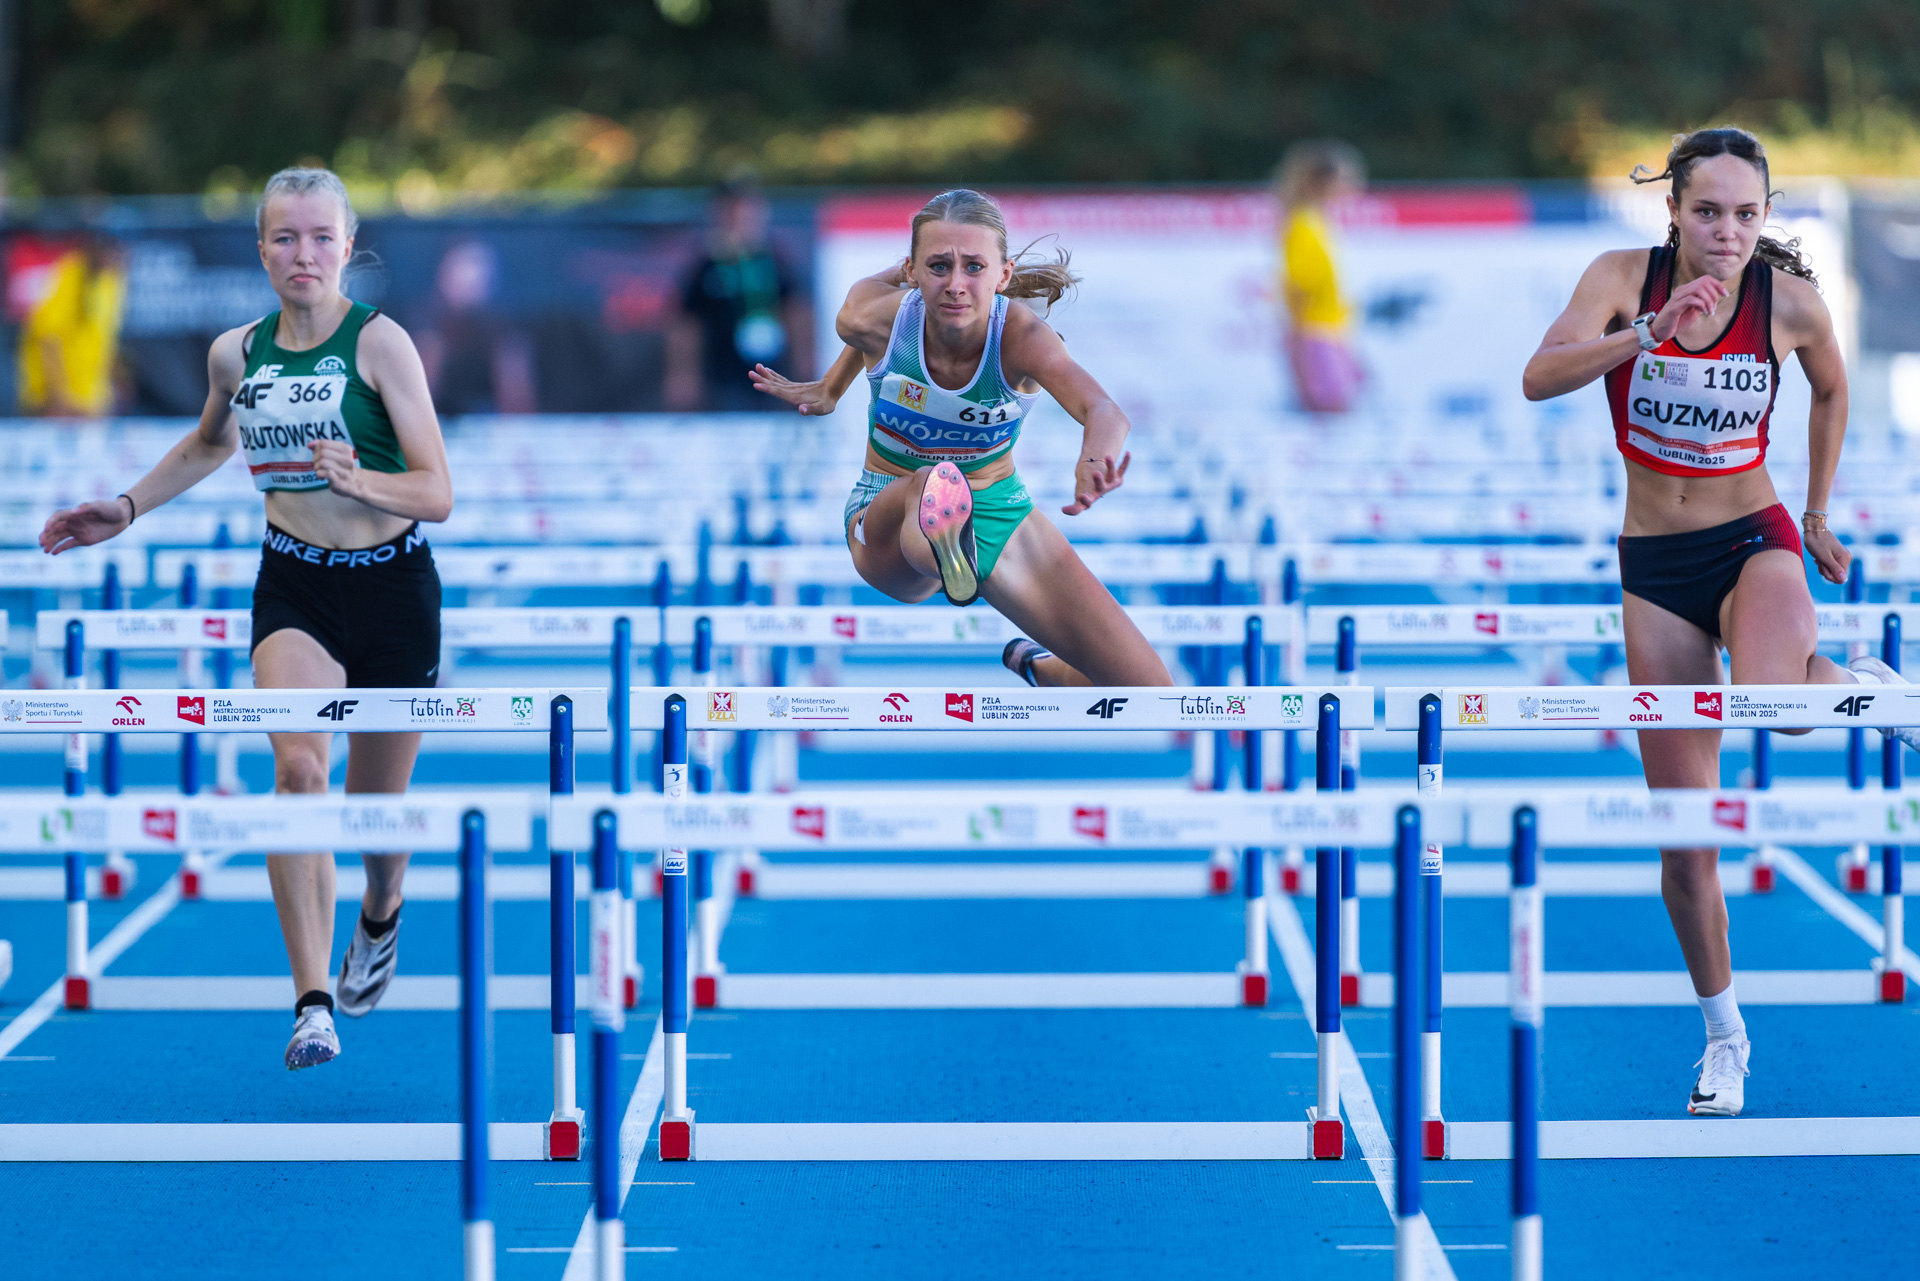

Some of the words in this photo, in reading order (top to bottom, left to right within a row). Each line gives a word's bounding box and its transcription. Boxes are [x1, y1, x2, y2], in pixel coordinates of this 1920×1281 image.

[1704, 366, 1767, 392] 1103
[234, 382, 274, 409] 4F
[289, 382, 332, 404] 366
[898, 396, 925, 412] PZLA
[959, 407, 1009, 425] 611
[1633, 397, 1761, 432] GUZMAN
[239, 420, 346, 451] DŁUTOWSKA
[880, 412, 1010, 443] WÓJCIAK
[904, 448, 945, 460] LUBLIN
[1658, 448, 1696, 462] LUBLIN
[1698, 456, 1726, 464] 2025
[271, 474, 300, 484] LUBLIN
[265, 528, 324, 564] NIKE
[327, 545, 397, 568] PRO
[317, 700, 360, 721] 4F
[389, 698, 454, 716] lublin
[819, 705, 850, 713] Turystyki
[1086, 698, 1129, 718] 4F
[1159, 696, 1224, 714] lublin
[1542, 706, 1564, 714] Sportu
[1570, 706, 1600, 714] Turystyki
[1833, 696, 1876, 716] 4F
[112, 718, 145, 726] ORLEN
[709, 712, 736, 720] PZLA
[879, 714, 913, 722] ORLEN
[982, 712, 1008, 720] LUBLIN
[1010, 712, 1030, 720] 2025
[1460, 714, 1486, 723] PZLA
[1629, 713, 1662, 722] ORLEN
[1730, 710, 1757, 718] LUBLIN
[1759, 710, 1778, 718] 2025
